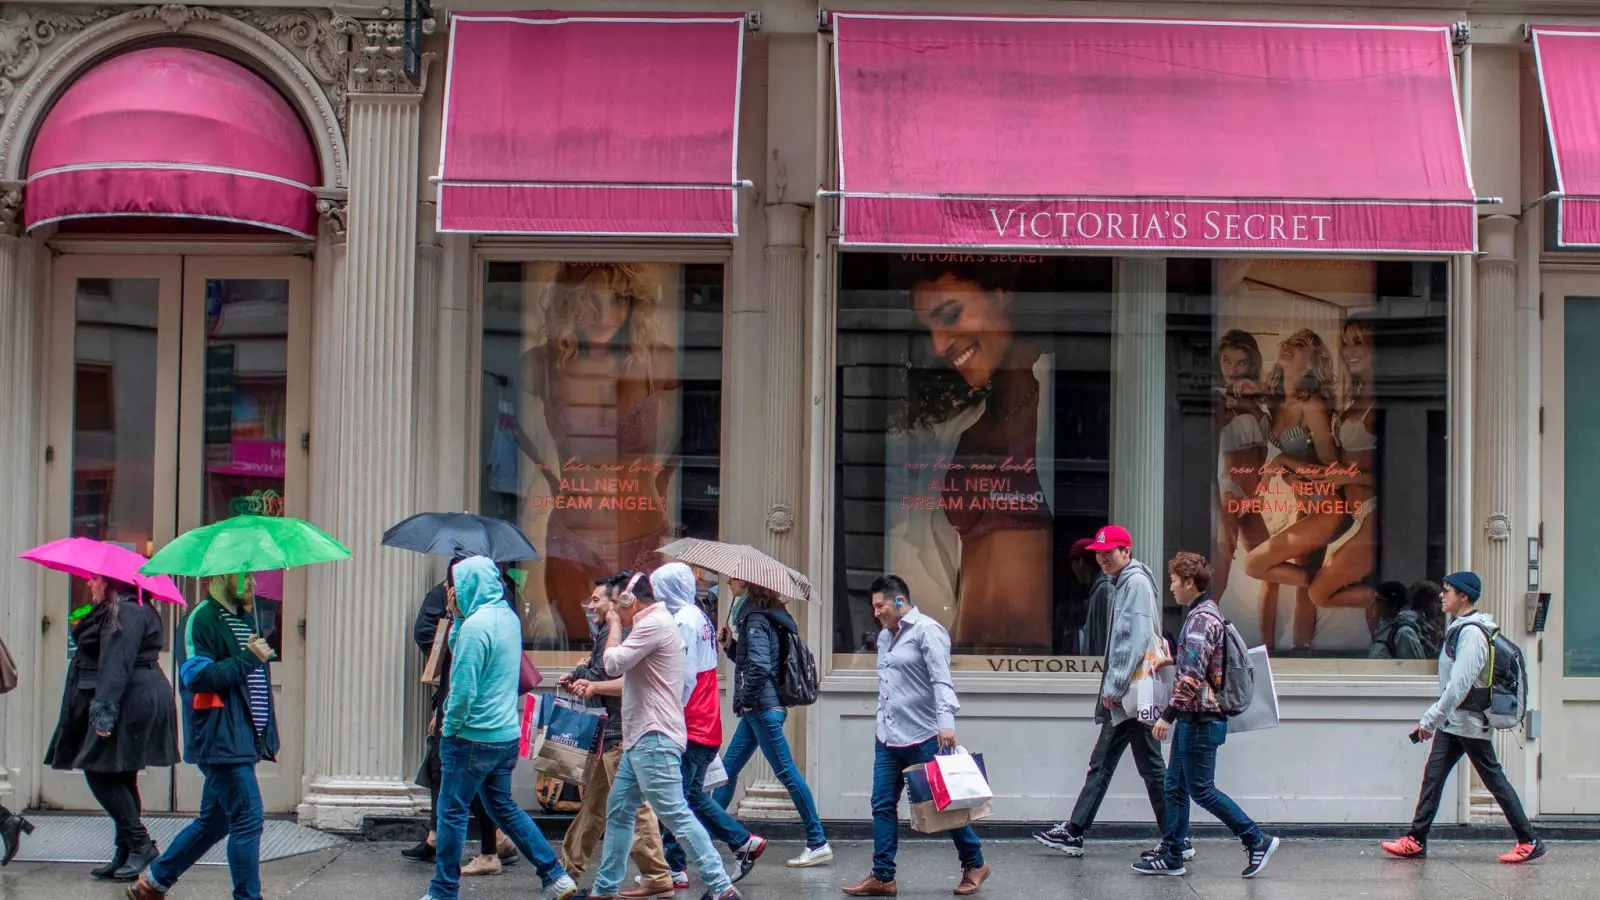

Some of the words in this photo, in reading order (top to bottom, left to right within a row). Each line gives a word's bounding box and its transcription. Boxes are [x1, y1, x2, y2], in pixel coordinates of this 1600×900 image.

[989, 208, 1188, 239] VICTORIA'S
[1204, 210, 1331, 241] SECRET
[559, 477, 590, 492] ALL
[594, 478, 639, 492] NEW!
[928, 477, 960, 492] ALL
[965, 477, 1011, 492] NEW!
[1254, 481, 1285, 495] ALL
[1291, 481, 1336, 496] NEW!
[532, 496, 593, 510] DREAM
[598, 496, 666, 511] ANGELS
[900, 495, 963, 510] DREAM
[968, 496, 1039, 511] ANGELS
[1228, 499, 1289, 514] DREAM
[1296, 500, 1363, 515] ANGELS
